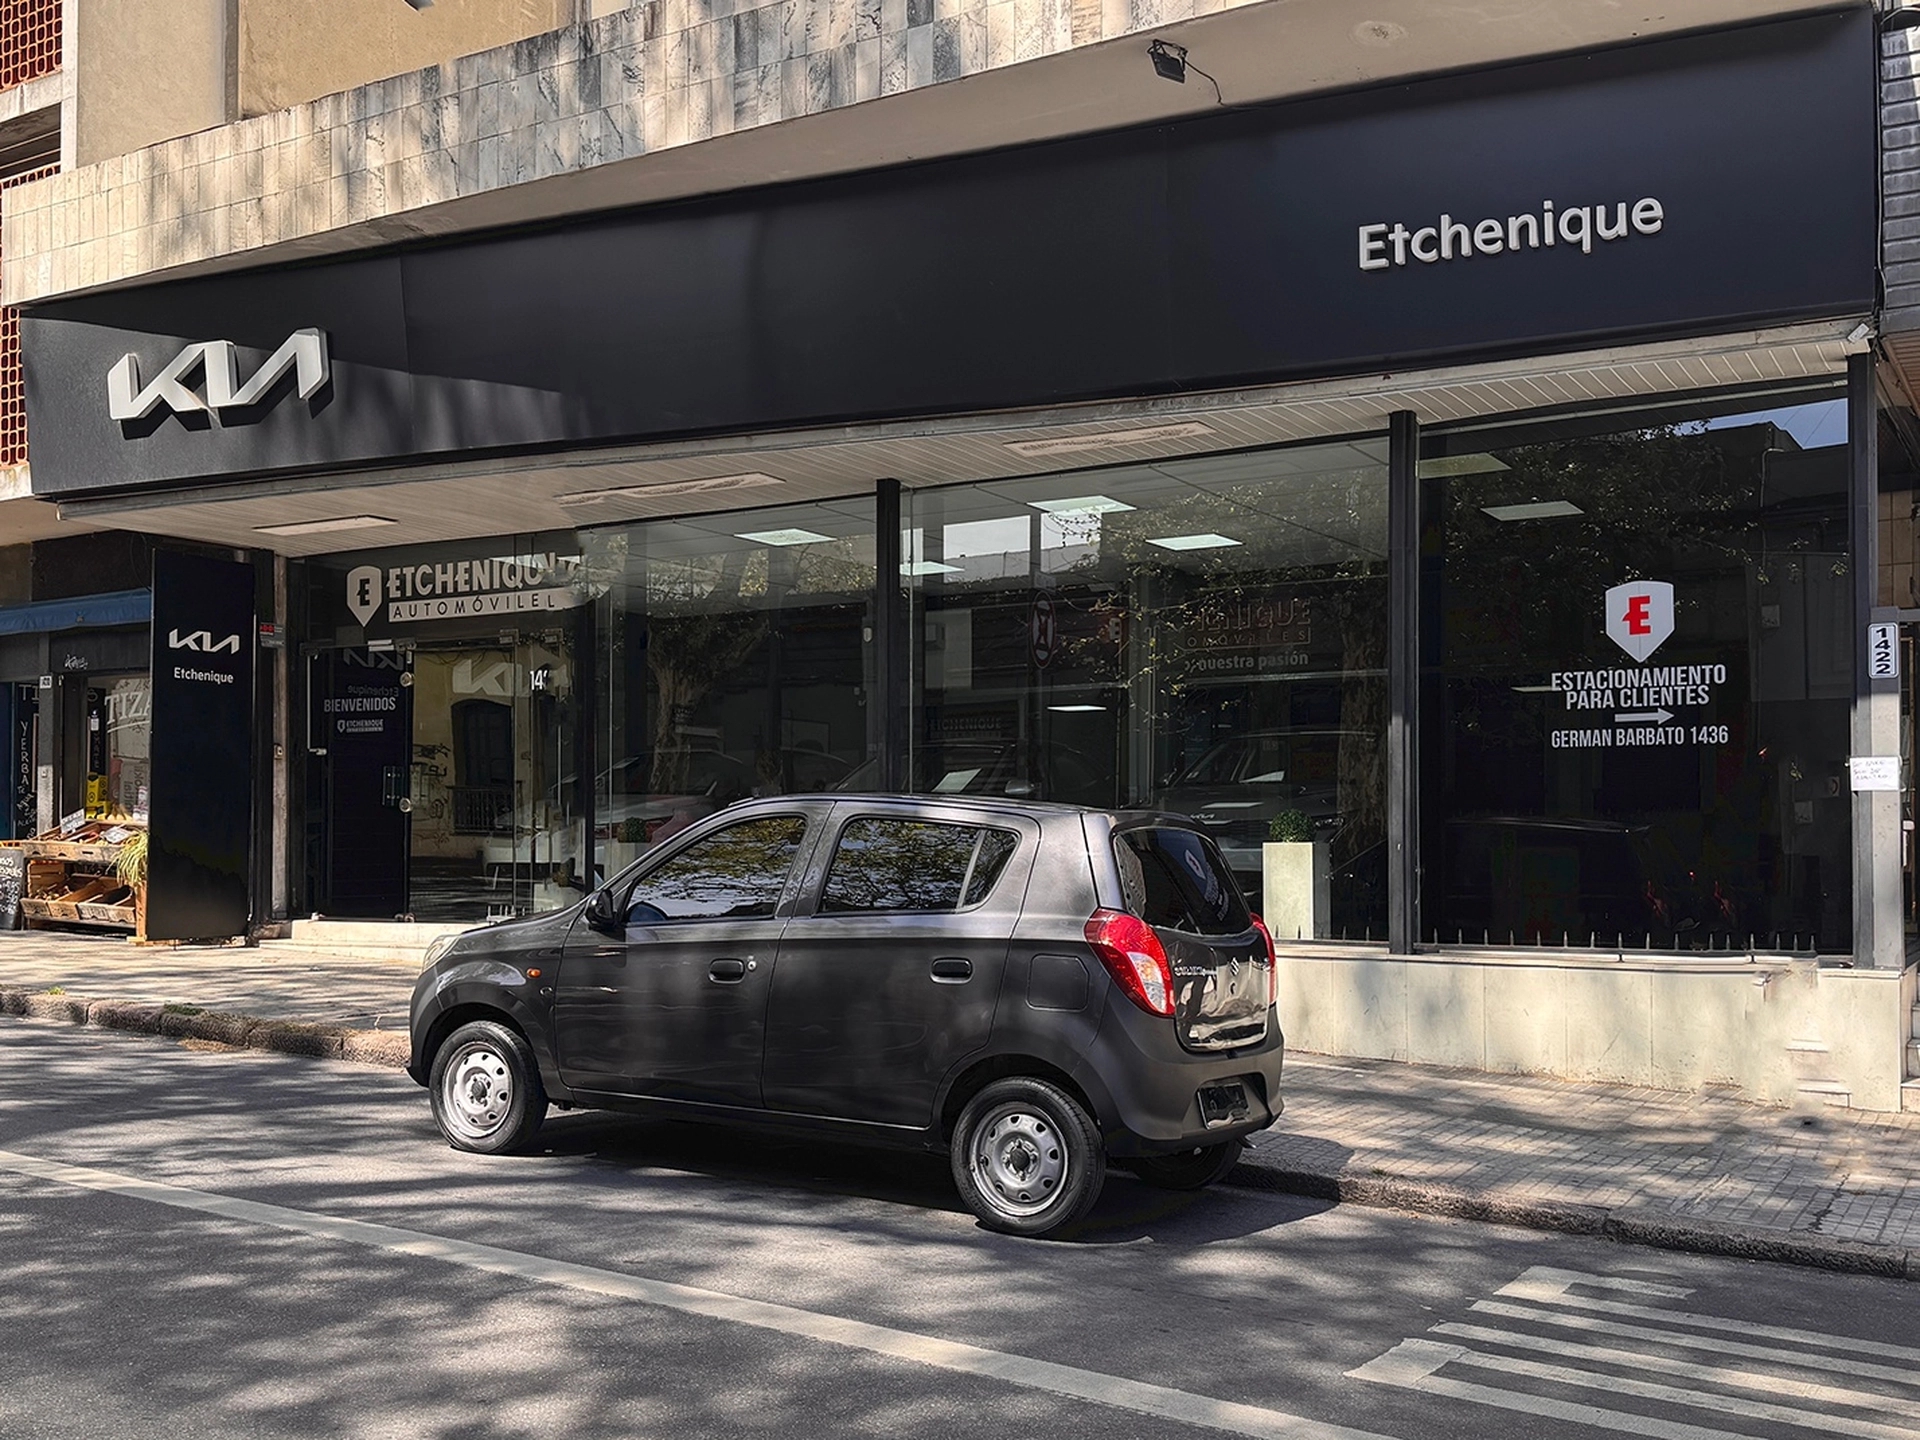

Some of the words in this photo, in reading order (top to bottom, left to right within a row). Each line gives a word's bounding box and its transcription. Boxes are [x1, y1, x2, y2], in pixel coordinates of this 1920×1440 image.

[1358, 197, 1664, 271] Etchenique
[107, 327, 328, 421] KIA
[1621, 595, 1652, 636] E
[168, 628, 240, 655] KIA
[1874, 627, 1892, 675] 1422
[173, 666, 234, 685] Etchenique
[1550, 663, 1727, 692] ESTACIONAMIENTO
[323, 696, 397, 713] BIENVENIDOS
[1566, 690, 1616, 710] PARA
[1619, 684, 1710, 708] CLIENTES
[1551, 728, 1612, 748] GERMAN
[1615, 726, 1685, 746] BARBATO
[1690, 725, 1729, 744] 1436
[20, 720, 30, 785] YERBA
